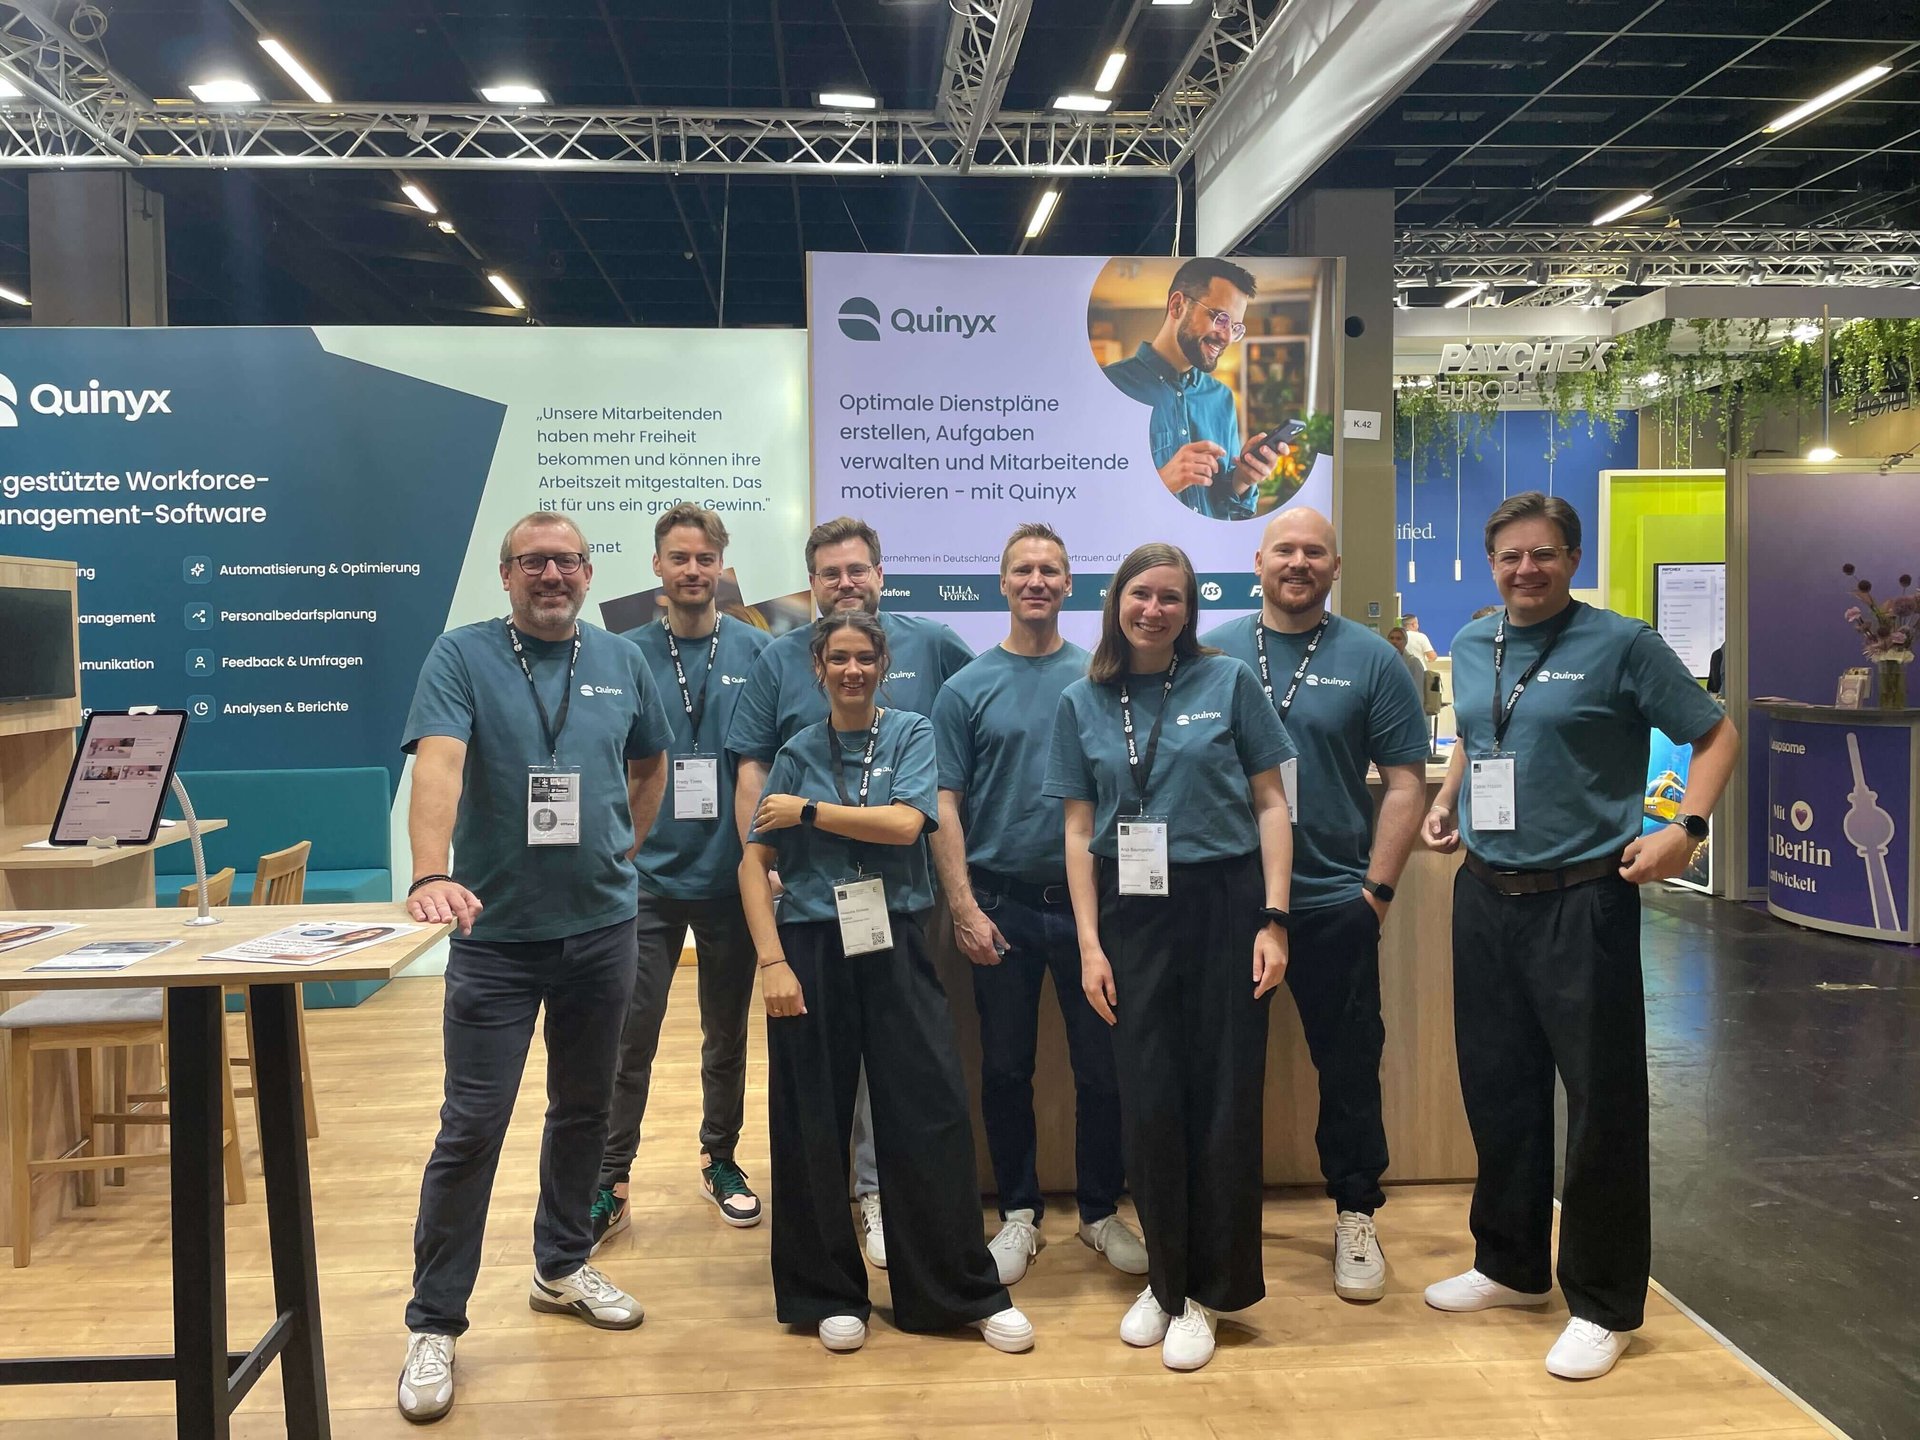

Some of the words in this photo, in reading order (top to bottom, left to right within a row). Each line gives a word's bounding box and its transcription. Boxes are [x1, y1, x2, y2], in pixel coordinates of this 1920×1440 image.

[891, 305, 997, 339] Quinyx
[1437, 341, 1612, 374] PAYCHEX
[1437, 381, 1532, 402] EUROPE
[30, 379, 172, 421] Quinyx
[840, 394, 934, 415] Optimale
[939, 394, 1059, 417] Dienstpläne
[536, 407, 598, 422] „Unsere
[602, 407, 722, 420] Mitarbeitenden
[1353, 420, 1372, 429] K.42
[537, 430, 589, 443] haben
[593, 430, 635, 443] mehr
[639, 430, 697, 443] Freiheit
[840, 424, 930, 443] erstellen,
[936, 424, 1034, 446] Aufgaben
[538, 453, 630, 466] bekommen
[635, 453, 664, 466] und
[669, 453, 727, 466] können
[732, 453, 761, 466] ihre
[840, 453, 939, 471] verwalten
[946, 453, 983, 471] und
[990, 453, 1129, 471] Mitarbeitende
[0, 470, 120, 499] gestützte
[126, 469, 269, 491] Workforce-
[538, 476, 621, 489] Arbeitszeit
[625, 475, 729, 492] mitgestalten.
[732, 476, 762, 489] Das
[840, 482, 949, 499] motivieren
[970, 482, 1004, 499] mit
[1008, 482, 1077, 504] Quinyx
[538, 498, 557, 511] ist
[561, 498, 582, 511] für
[586, 501, 615, 511] uns
[619, 498, 643, 511] ein
[933, 553, 941, 563] in
[943, 553, 1000, 564] Deutschland
[1106, 553, 1122, 562] auf
[219, 563, 326, 577] Automatisierung
[328, 563, 339, 574] &
[341, 562, 421, 576] Optimierung
[1203, 586, 1220, 596] ISS
[77, 612, 156, 626] anagement
[220, 609, 377, 623] Personalbedarfsplanung
[222, 656, 285, 668] Feedback
[287, 656, 297, 667] &
[299, 654, 363, 669] Umfragen
[1298, 656, 1310, 672] Quinyx
[889, 670, 916, 680] Quinyx
[1320, 677, 1352, 687] Quinyx
[1551, 671, 1585, 681] Quinyx
[594, 685, 623, 696] Quinyx
[223, 702, 282, 716] Analysen
[284, 702, 295, 713] &
[297, 701, 349, 713] Berichte
[1190, 710, 1222, 721] Quinyx
[1773, 803, 1786, 821] Mit
[1776, 833, 1832, 867] Berlin
